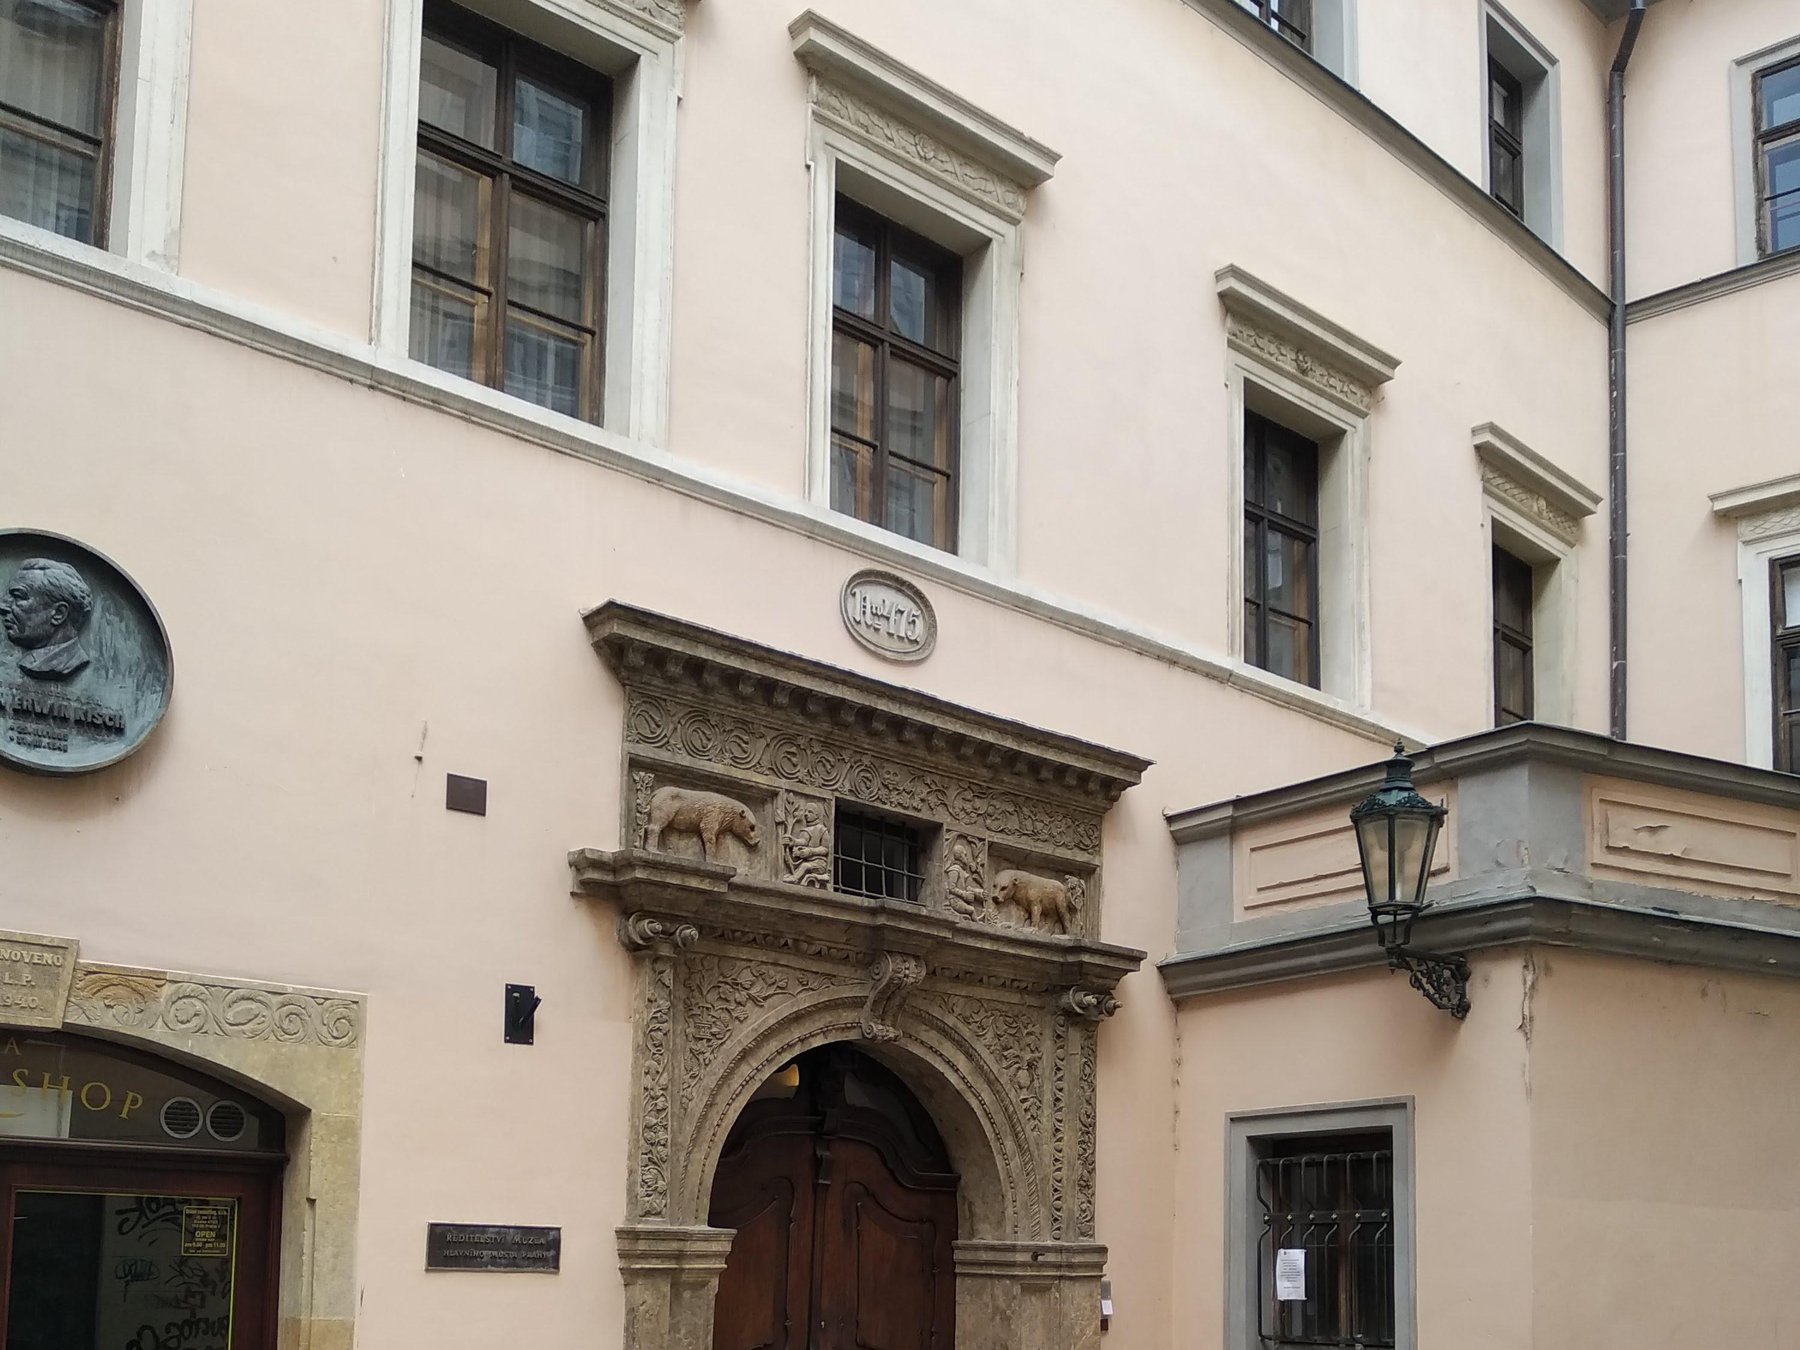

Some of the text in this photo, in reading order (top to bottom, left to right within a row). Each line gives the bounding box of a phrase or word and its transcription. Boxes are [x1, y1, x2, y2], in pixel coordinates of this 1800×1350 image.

[883, 599, 921, 642] 475
[14, 698, 126, 729] ERWIN KISCH
[11, 1068, 143, 1120] SHOP
[195, 1230, 216, 1238] OPEN
